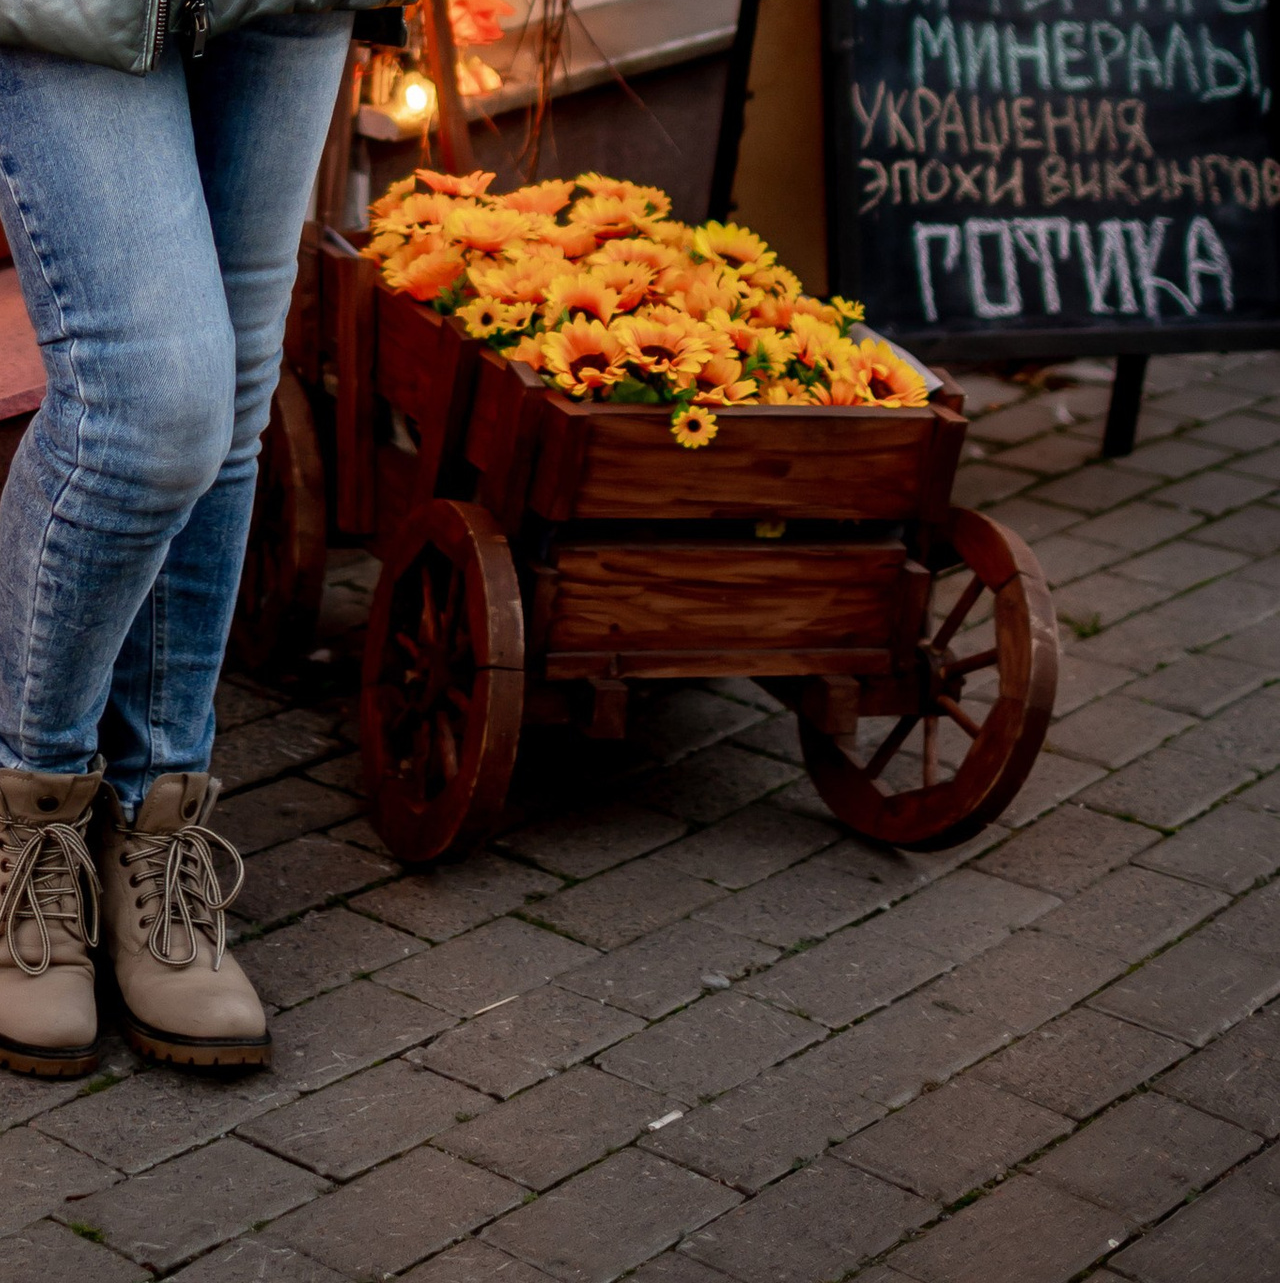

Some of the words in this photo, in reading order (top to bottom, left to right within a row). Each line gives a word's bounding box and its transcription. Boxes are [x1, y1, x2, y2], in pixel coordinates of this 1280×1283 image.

[911, 12, 1272, 115] МИНЕРАЛЫ,
[858, 155, 1027, 216] ЭПОХИ
[912, 215, 1234, 322] ГОТИКА
